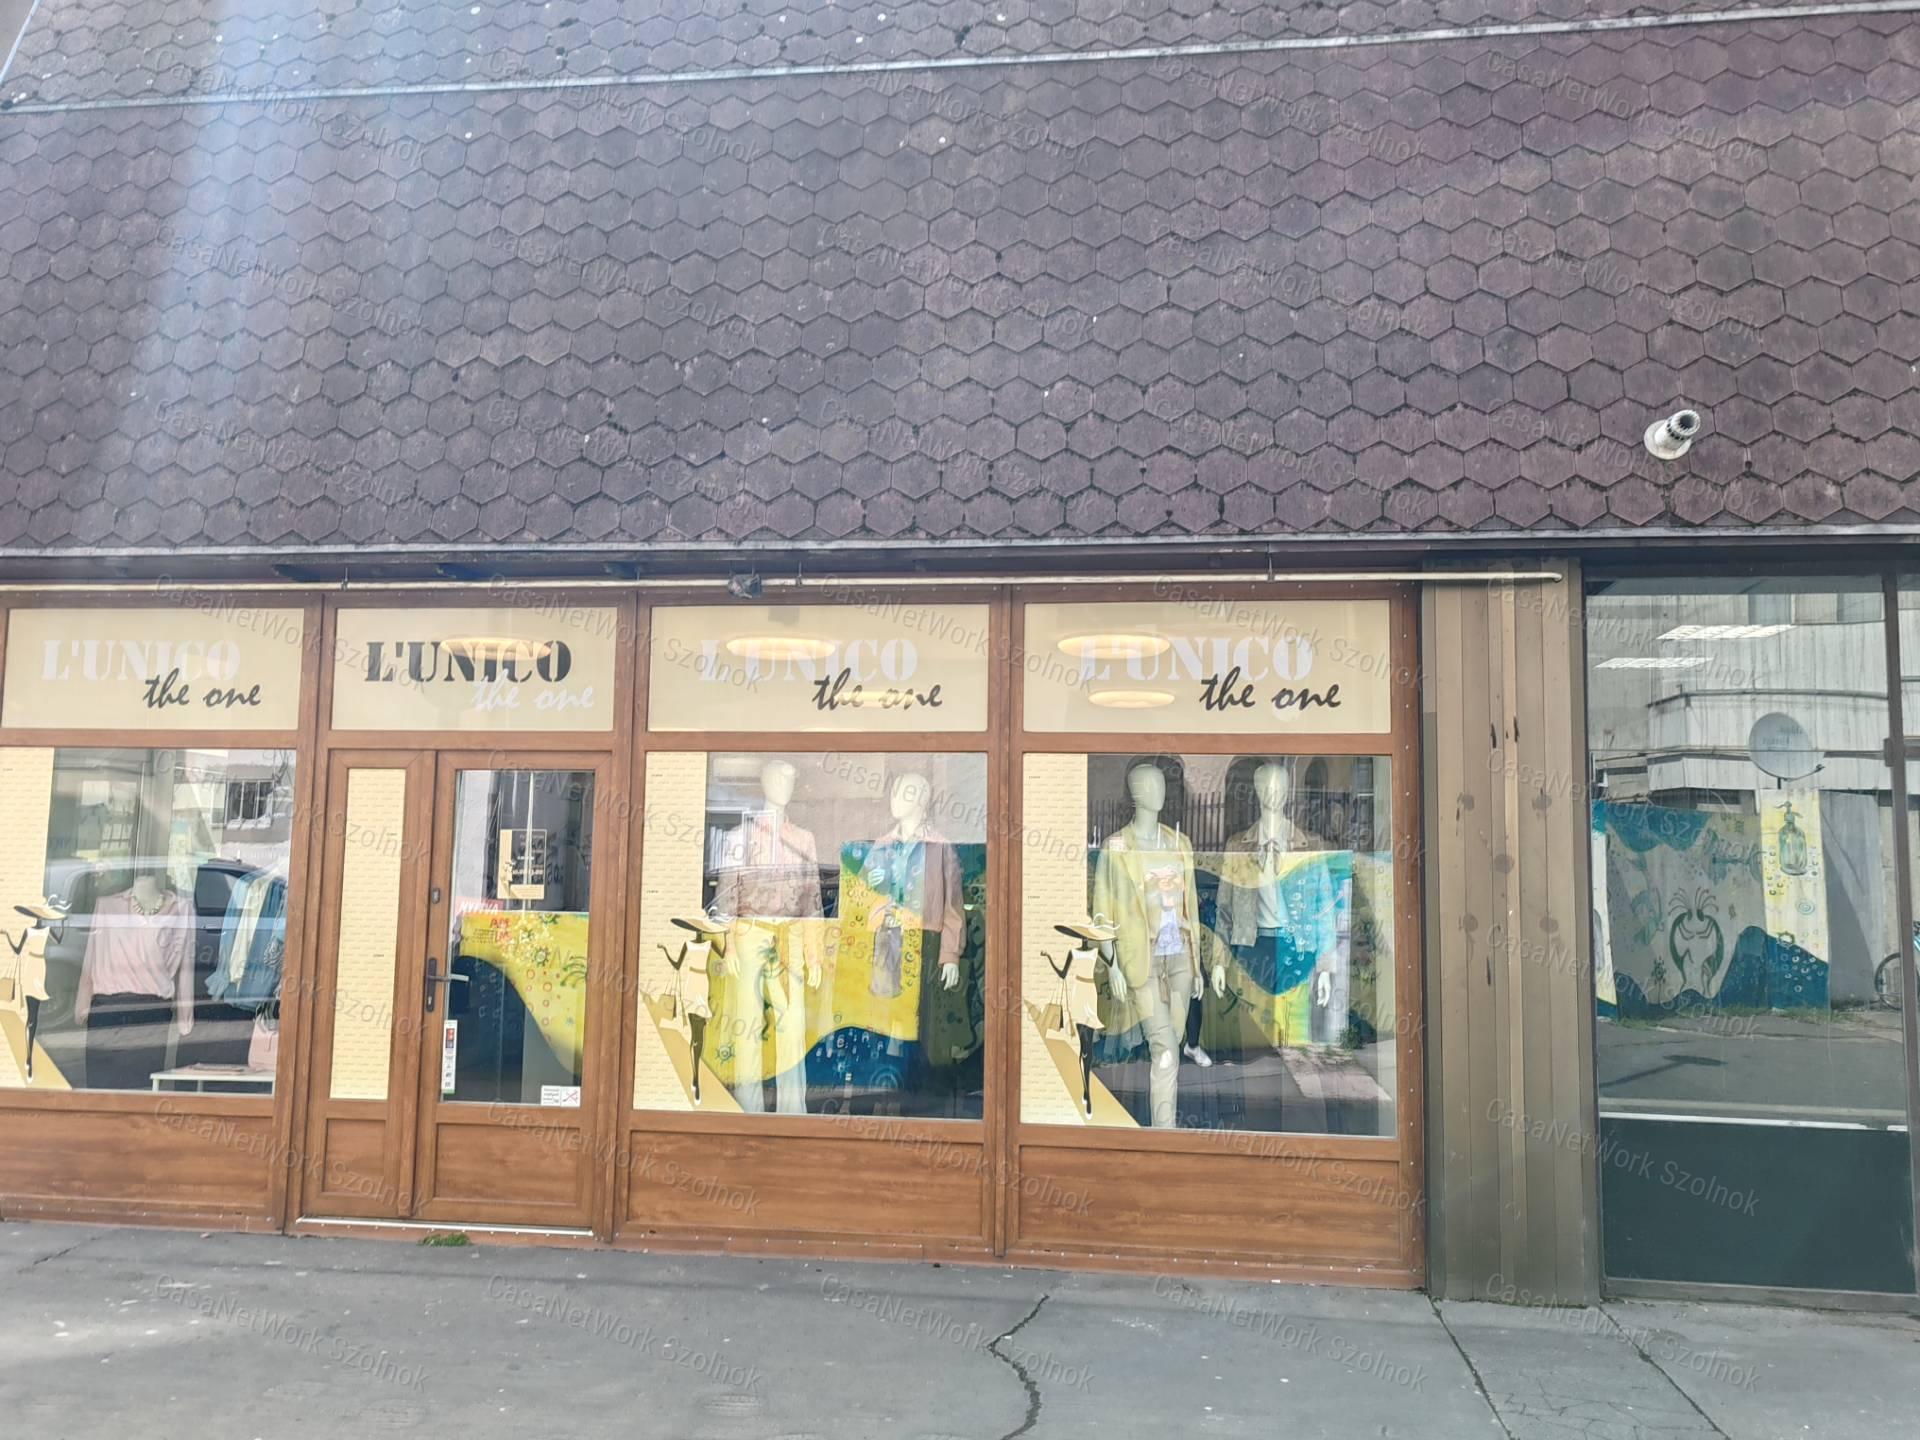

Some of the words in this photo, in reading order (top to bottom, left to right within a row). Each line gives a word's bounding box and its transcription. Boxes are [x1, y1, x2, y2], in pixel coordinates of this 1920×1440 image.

[41, 639, 241, 681] L'UNICO
[364, 639, 572, 683] L'UNICO
[699, 638, 919, 682] LUNICO
[1079, 636, 1314, 681] L'UNICO
[143, 667, 190, 709] the
[203, 684, 261, 708] one
[471, 668, 521, 712] the
[533, 686, 594, 711] one
[811, 667, 863, 710] the
[878, 684, 943, 710] one
[1199, 666, 1255, 711] the
[1271, 684, 1341, 710] one
